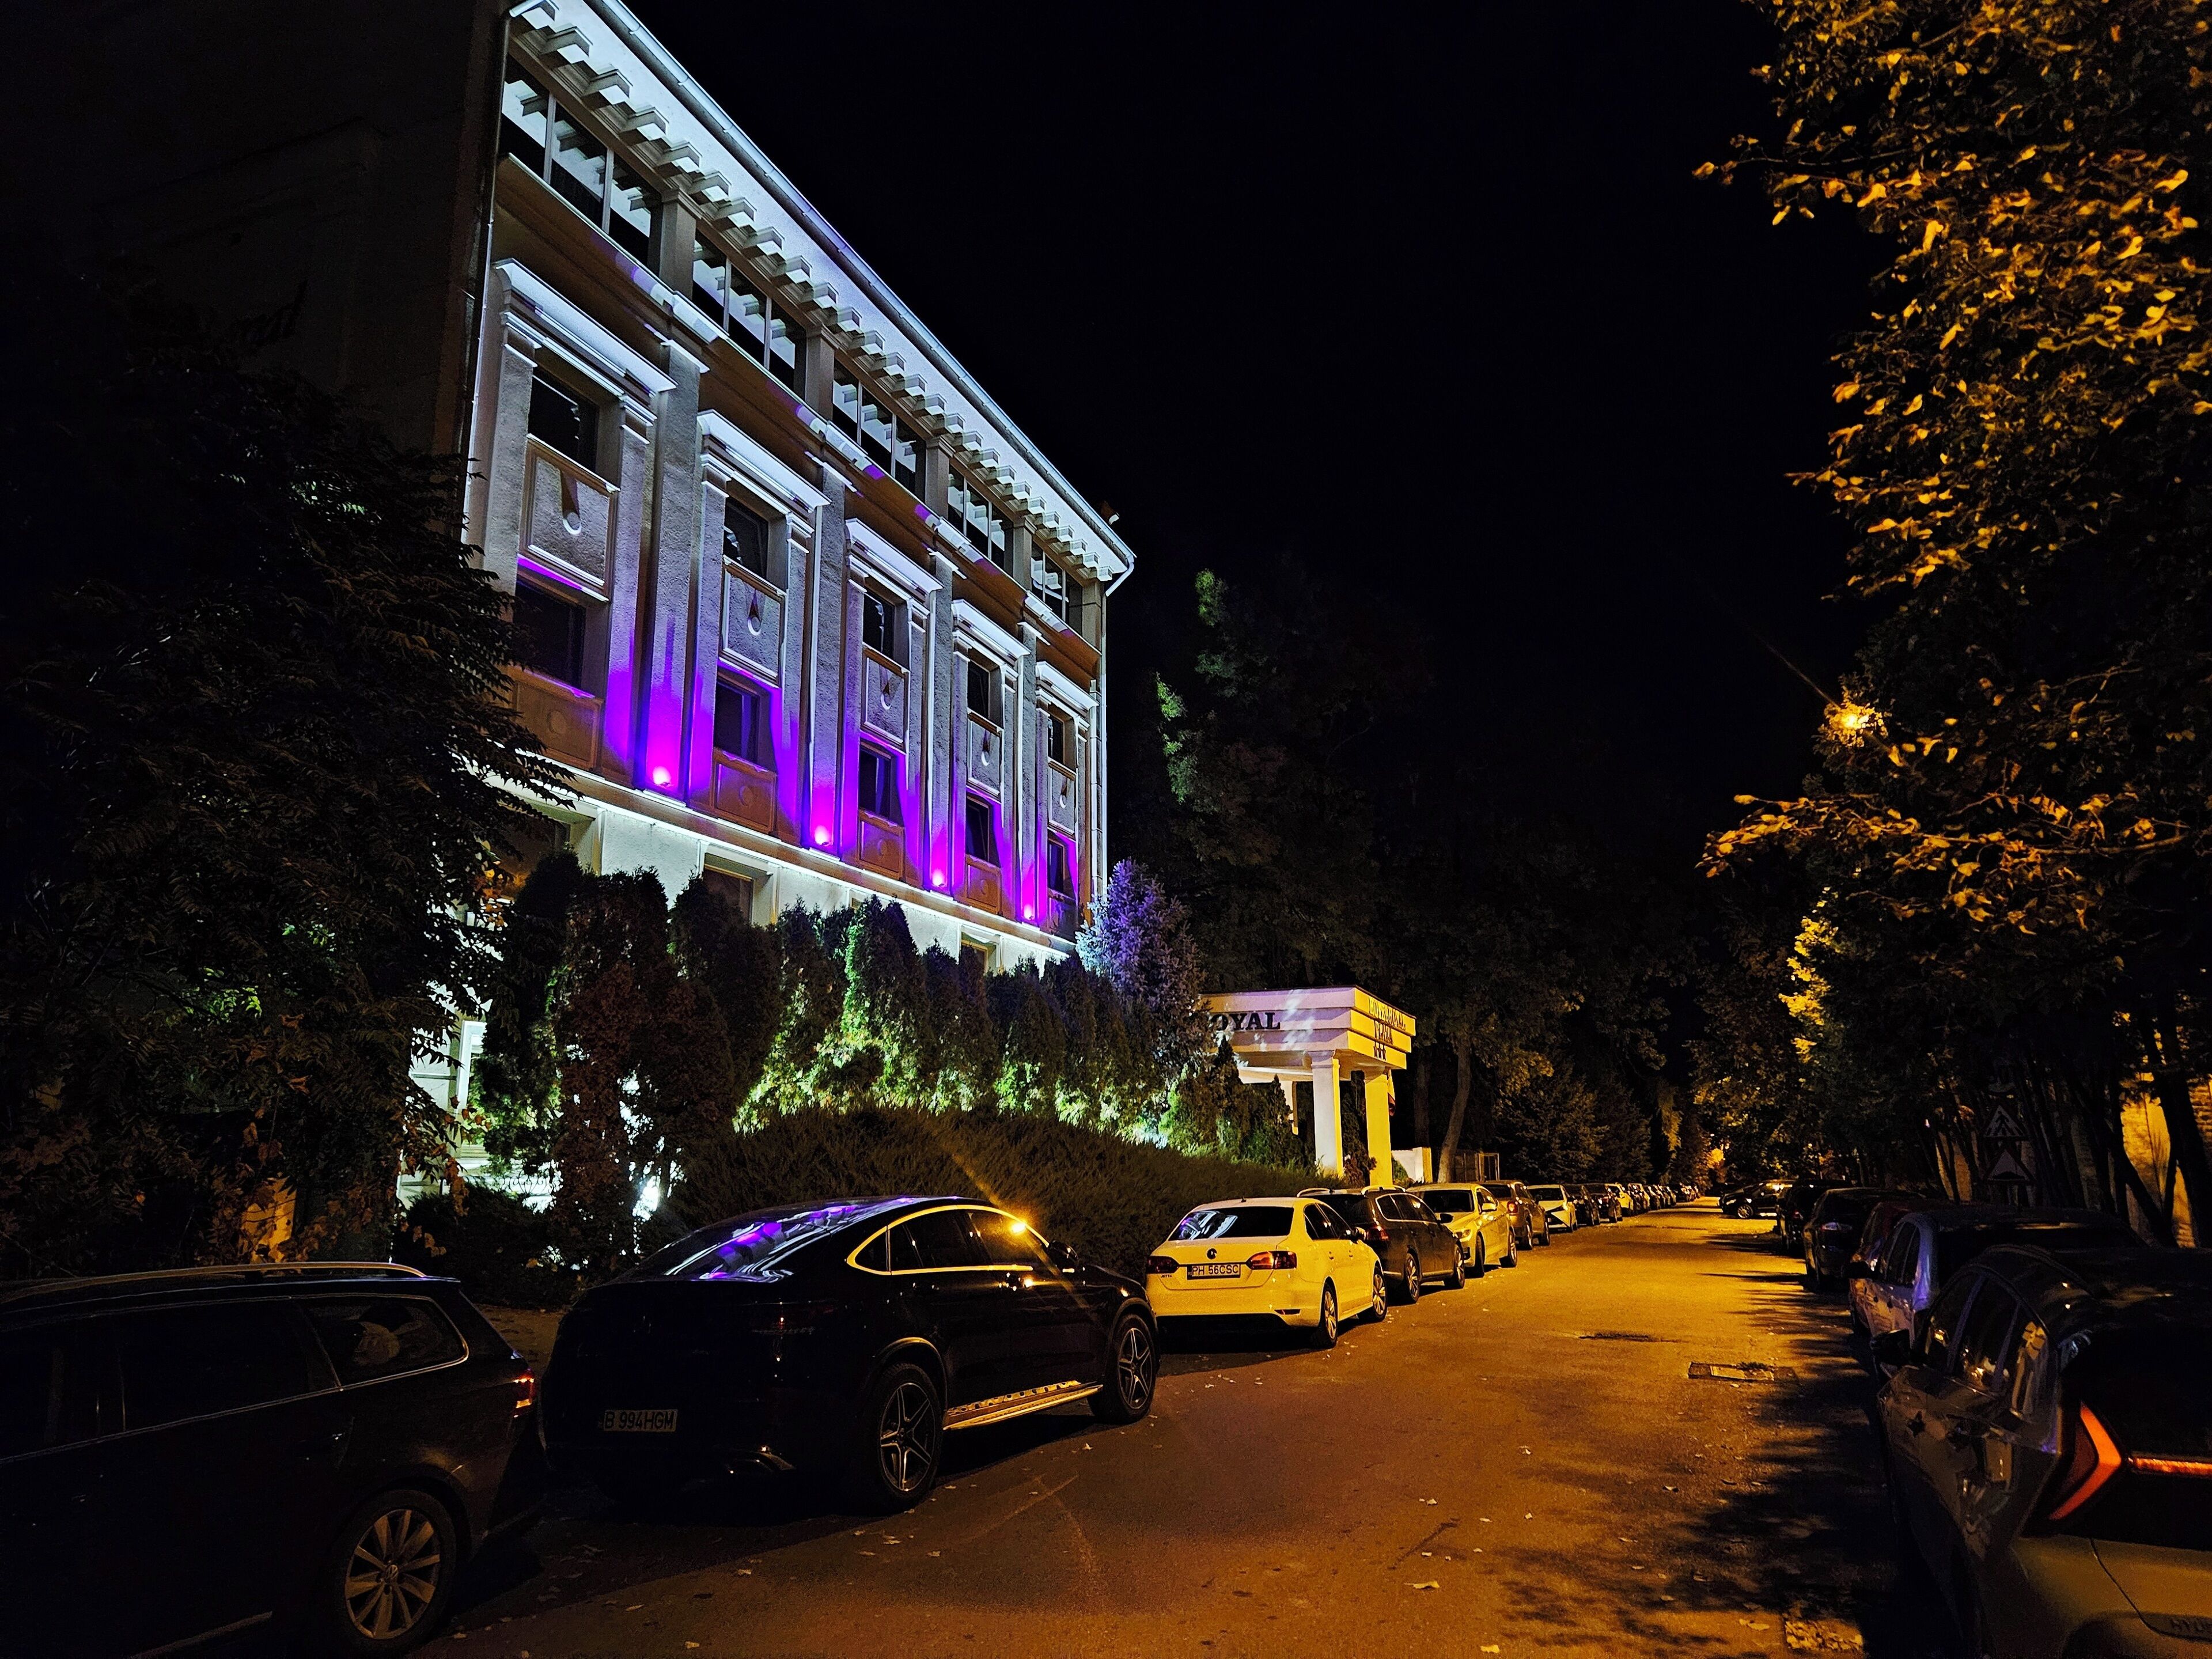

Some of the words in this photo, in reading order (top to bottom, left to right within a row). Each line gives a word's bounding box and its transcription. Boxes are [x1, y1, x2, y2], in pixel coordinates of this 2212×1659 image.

[1209, 1012, 1281, 1031] OYAL
[1192, 1266, 1205, 1275] PH
[1208, 1264, 1238, 1275] 56CSC
[605, 1411, 615, 1429] B
[619, 1411, 675, 1429] 994HGM
